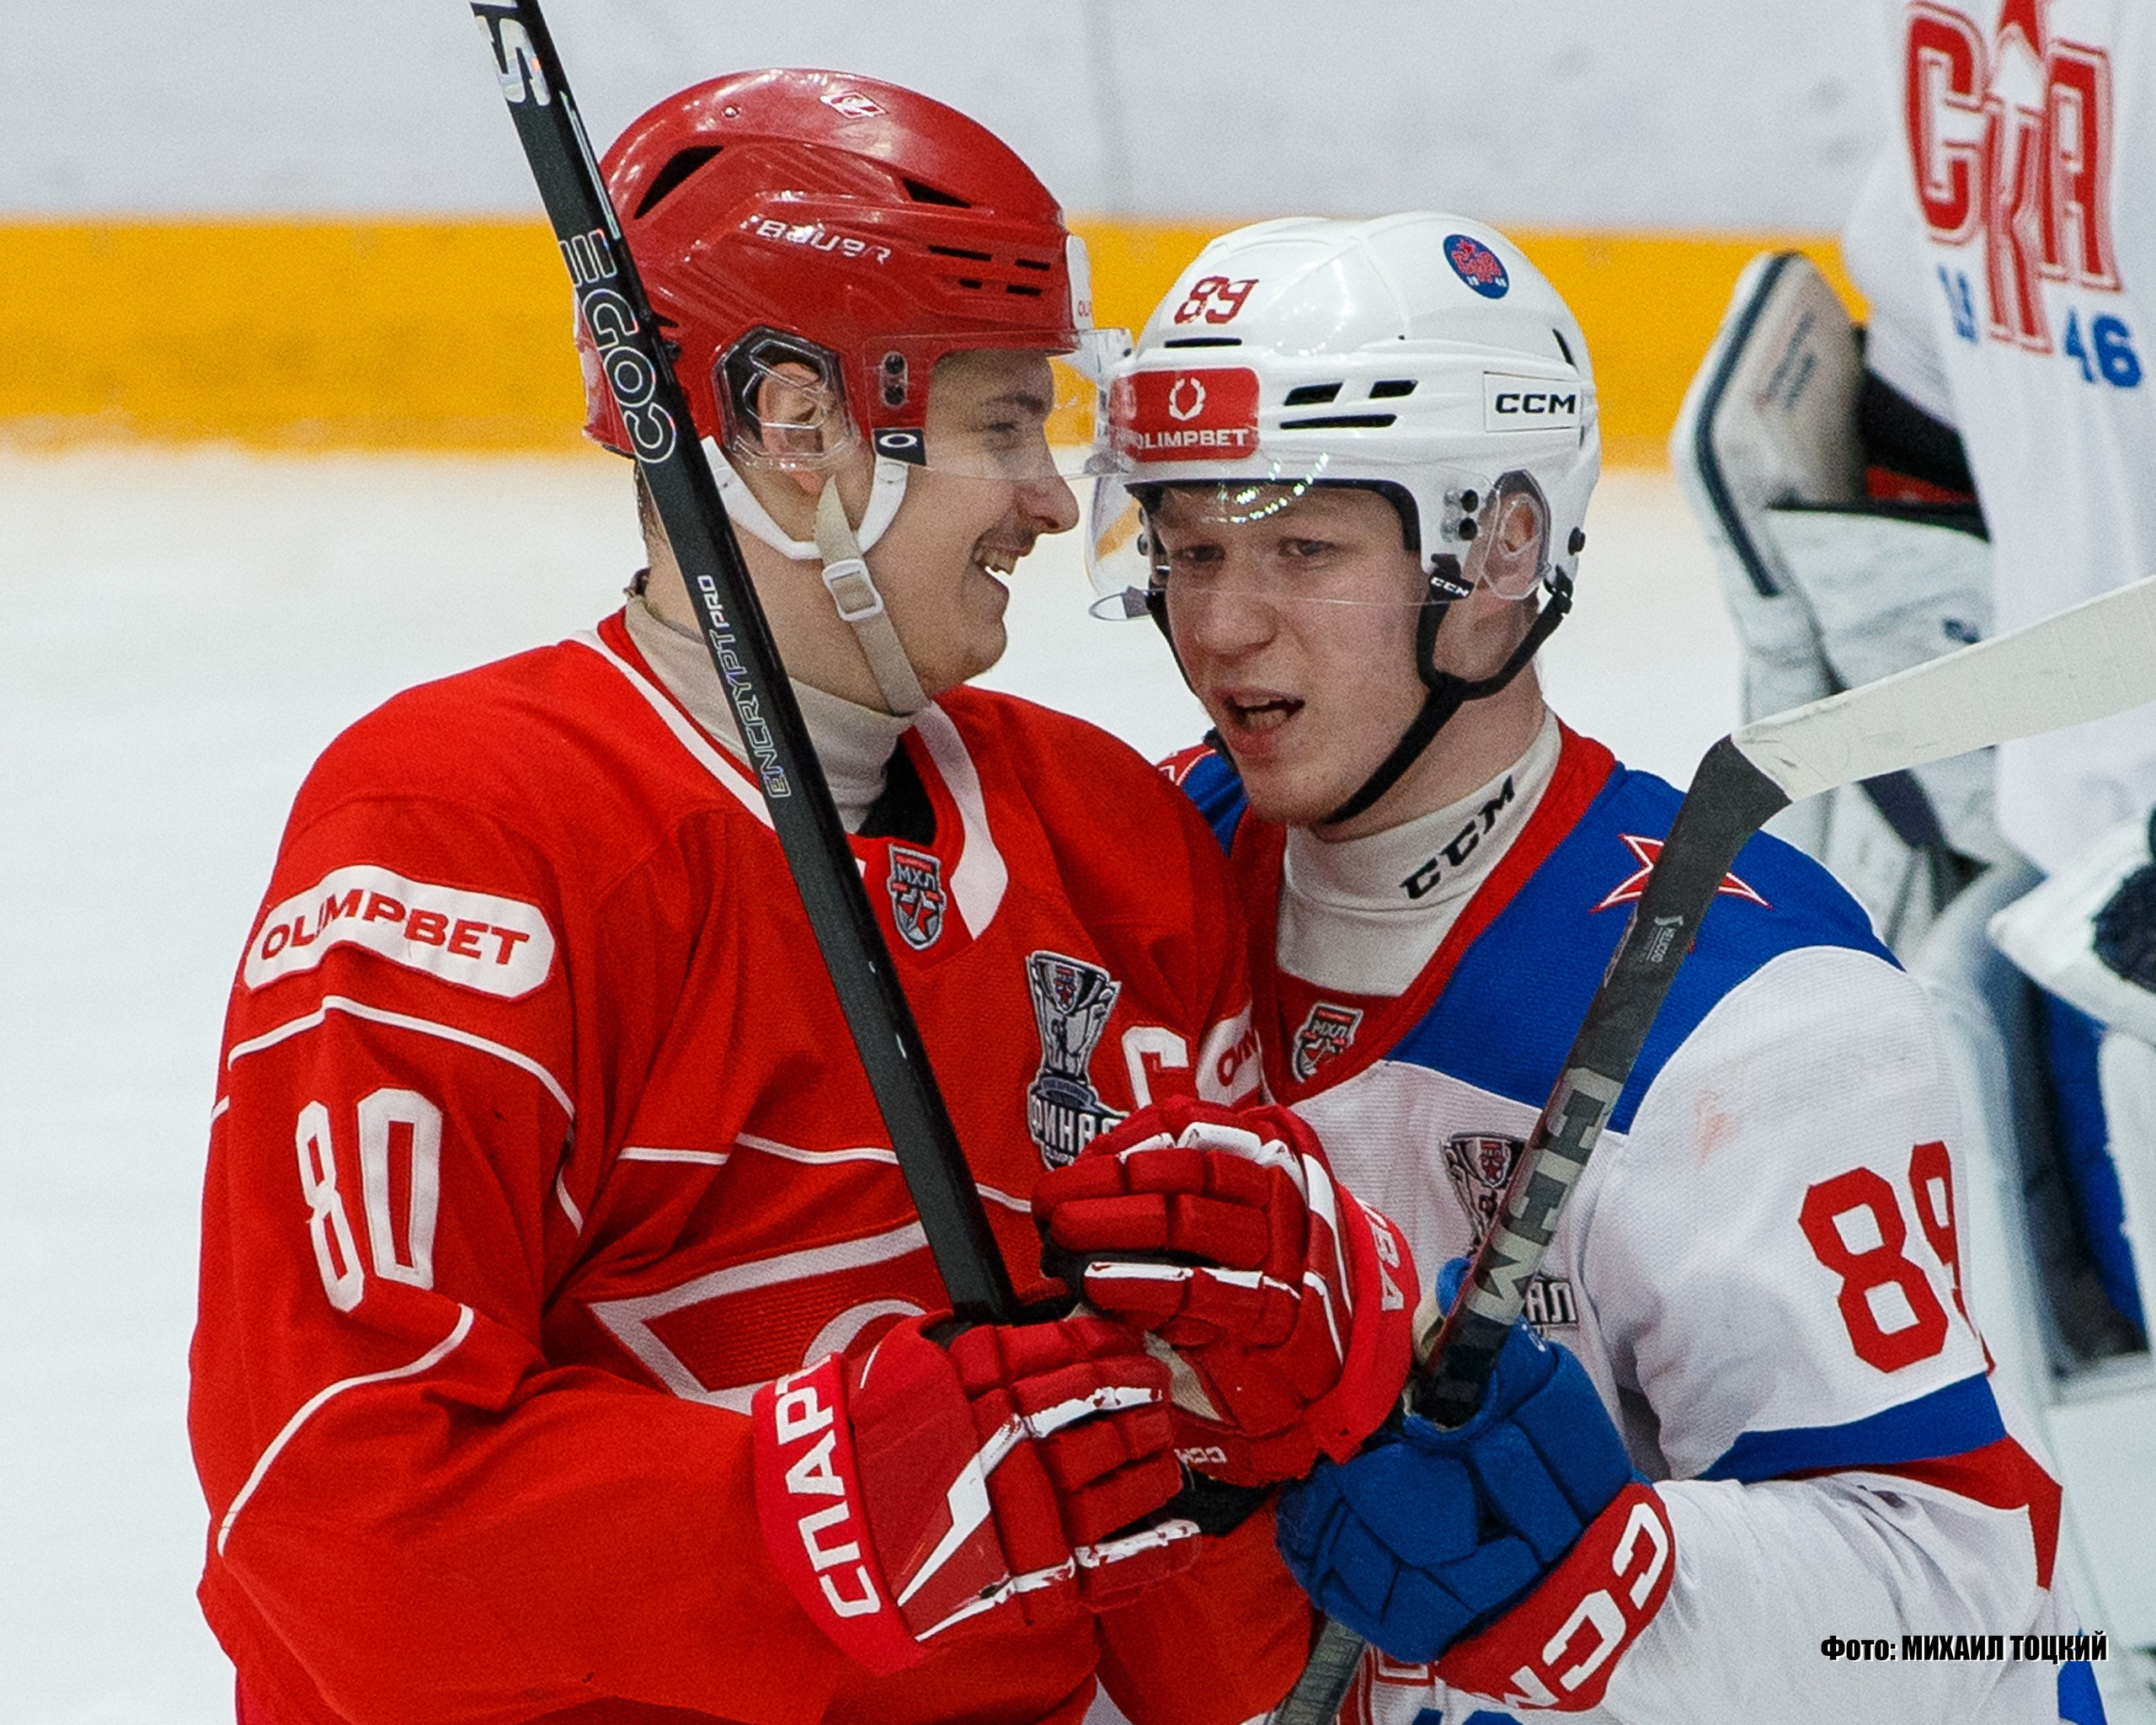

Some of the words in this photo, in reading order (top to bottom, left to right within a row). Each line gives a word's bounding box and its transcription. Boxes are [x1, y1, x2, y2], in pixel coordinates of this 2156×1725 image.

[1174, 276, 1259, 323] 89
[2063, 305, 2143, 390] 46
[1495, 392, 1577, 415] CCM
[696, 574, 730, 628] PRO
[1430, 576, 1470, 598] CCM
[708, 628, 792, 798] ENCRYPT
[1399, 775, 1516, 901] CCM
[260, 888, 530, 966] OLIMPBET
[295, 1087, 444, 1313] 80
[1464, 1065, 1625, 1327] CCM
[1798, 1140, 1996, 1375] 89
